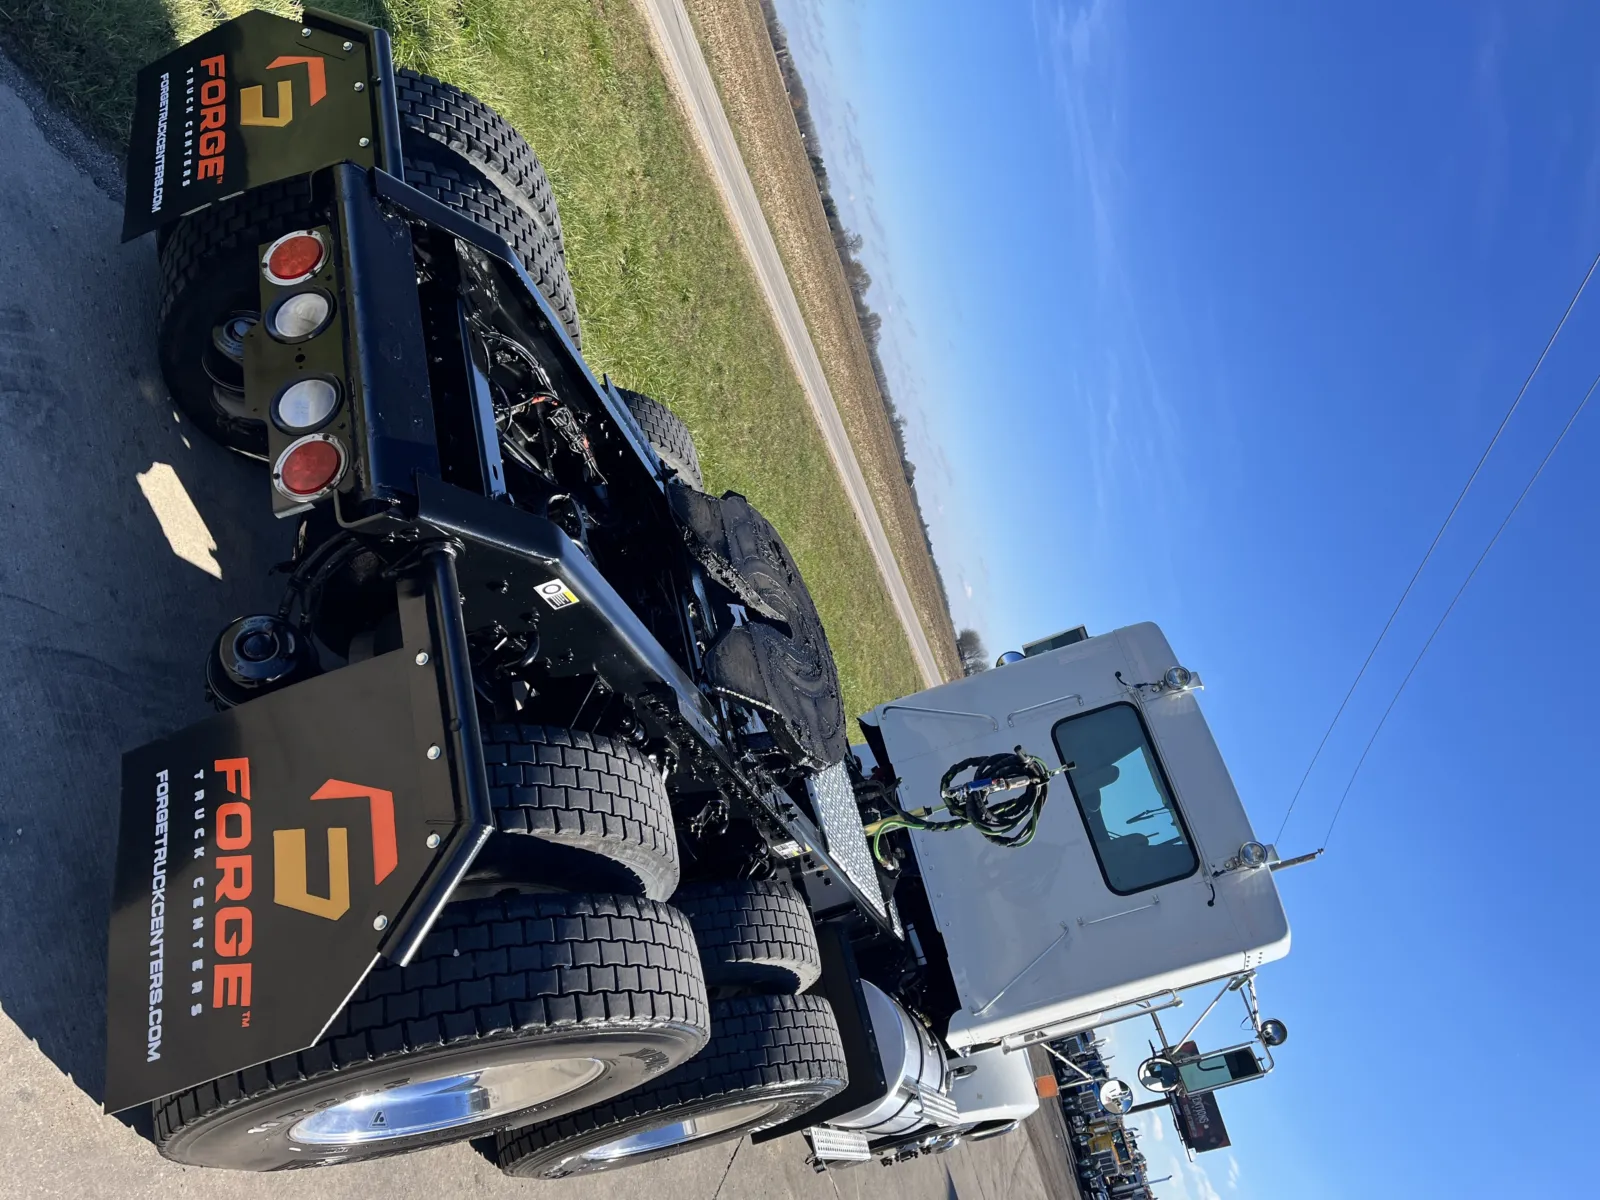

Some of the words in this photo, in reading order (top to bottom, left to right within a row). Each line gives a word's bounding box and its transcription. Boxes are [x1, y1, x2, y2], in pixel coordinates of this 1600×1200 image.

[151, 72, 170, 214] FORGETRUCKCENTERS.COM
[182, 120, 193, 187] CENTERS
[185, 66, 194, 114] TRUCK
[197, 54, 226, 181] FORGE
[193, 769, 205, 860] TRUCK
[146, 769, 169, 1063] FORGETRUCKCENTERS.COM
[190, 876, 205, 1017] CENTERS
[213, 757, 253, 1009] FORGE
